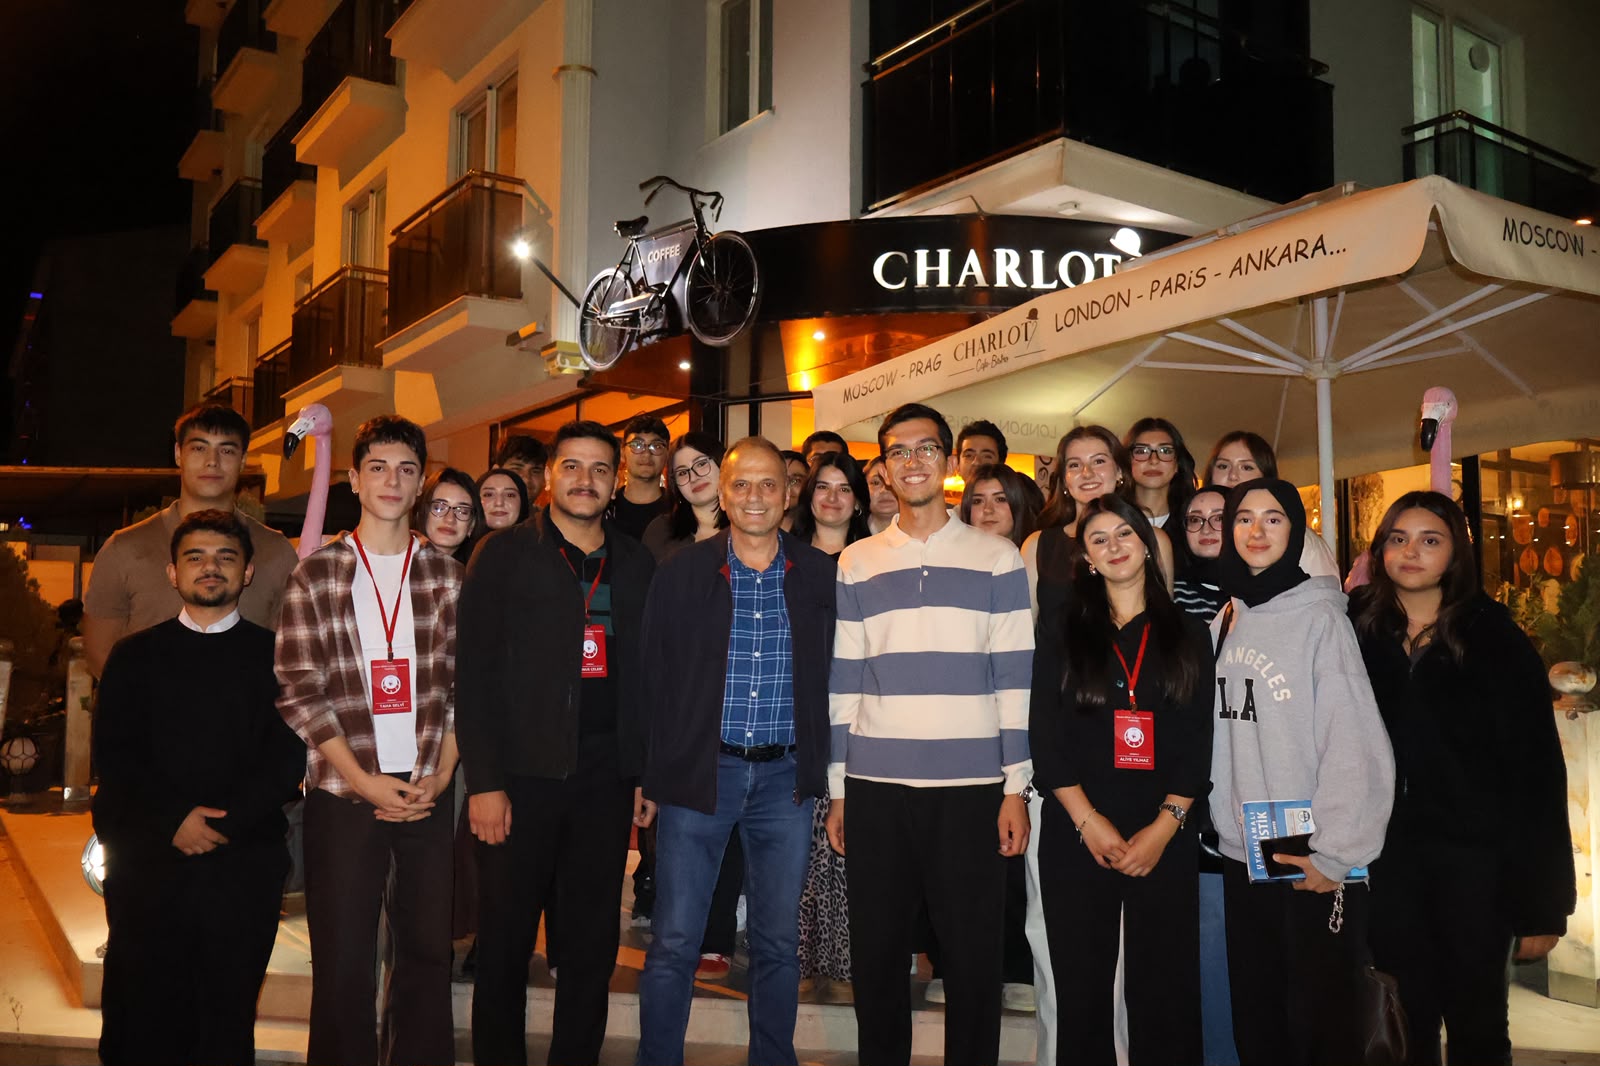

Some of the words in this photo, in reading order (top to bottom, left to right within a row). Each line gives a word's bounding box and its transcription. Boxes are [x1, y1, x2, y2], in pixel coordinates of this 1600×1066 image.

[648, 244, 681, 263] COFFEE
[1503, 217, 1584, 257] MOSCOW
[872, 248, 1122, 290] CHARLOT
[1055, 288, 1131, 333] LONDON
[1229, 234, 1346, 279] ANKARA...
[953, 320, 1032, 362] CHARLOT
[843, 369, 898, 404] MOSCOW
[909, 353, 942, 379] PRAG
[1225, 646, 1292, 702] ANGELES
